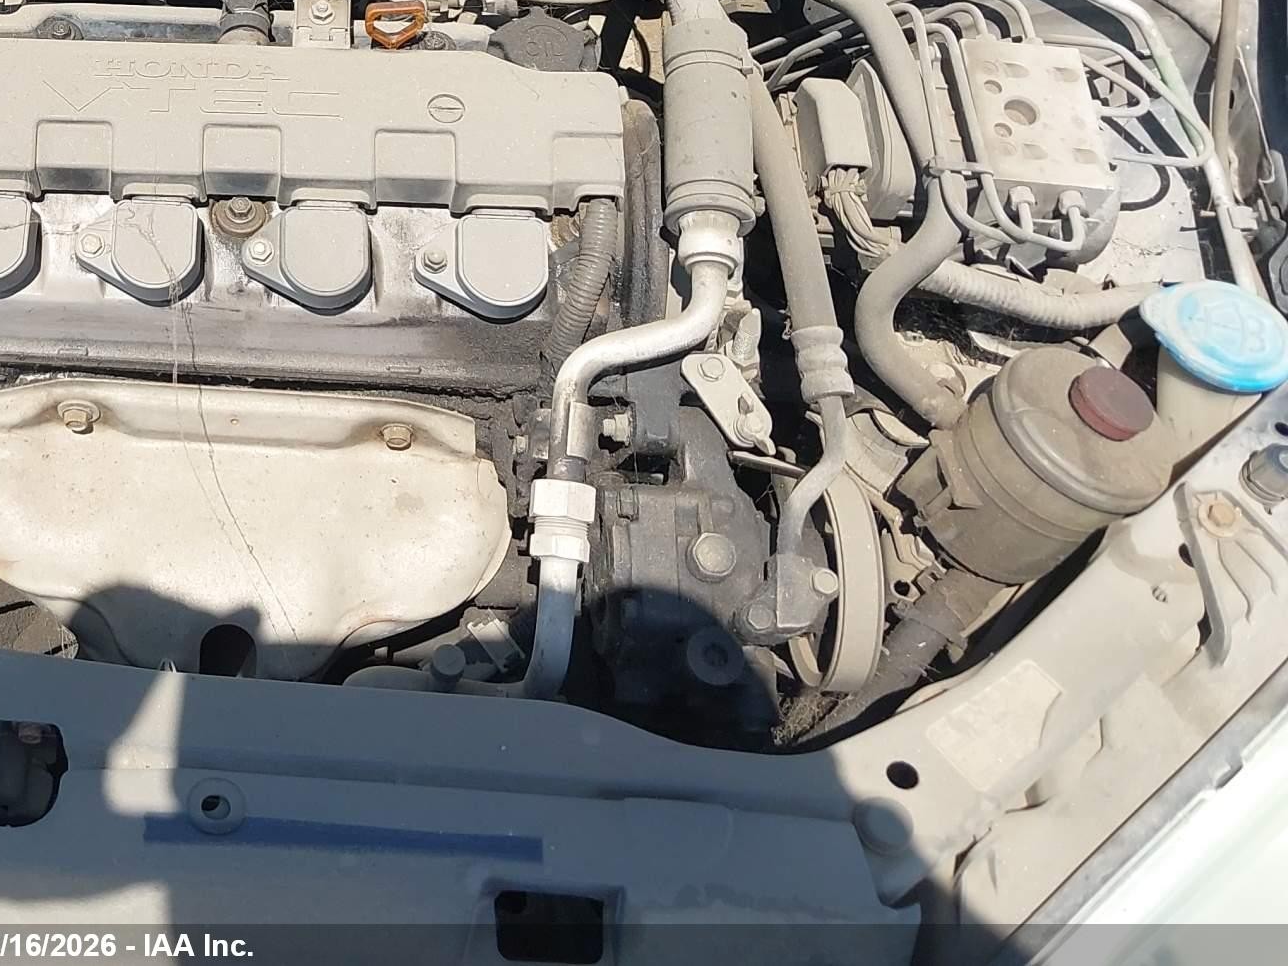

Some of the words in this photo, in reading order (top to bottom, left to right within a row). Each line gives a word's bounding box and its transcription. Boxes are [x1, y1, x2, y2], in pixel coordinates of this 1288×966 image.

[524, 40, 568, 57] OIL
[93, 58, 290, 81] HONDA
[42, 78, 346, 120] VTEC
